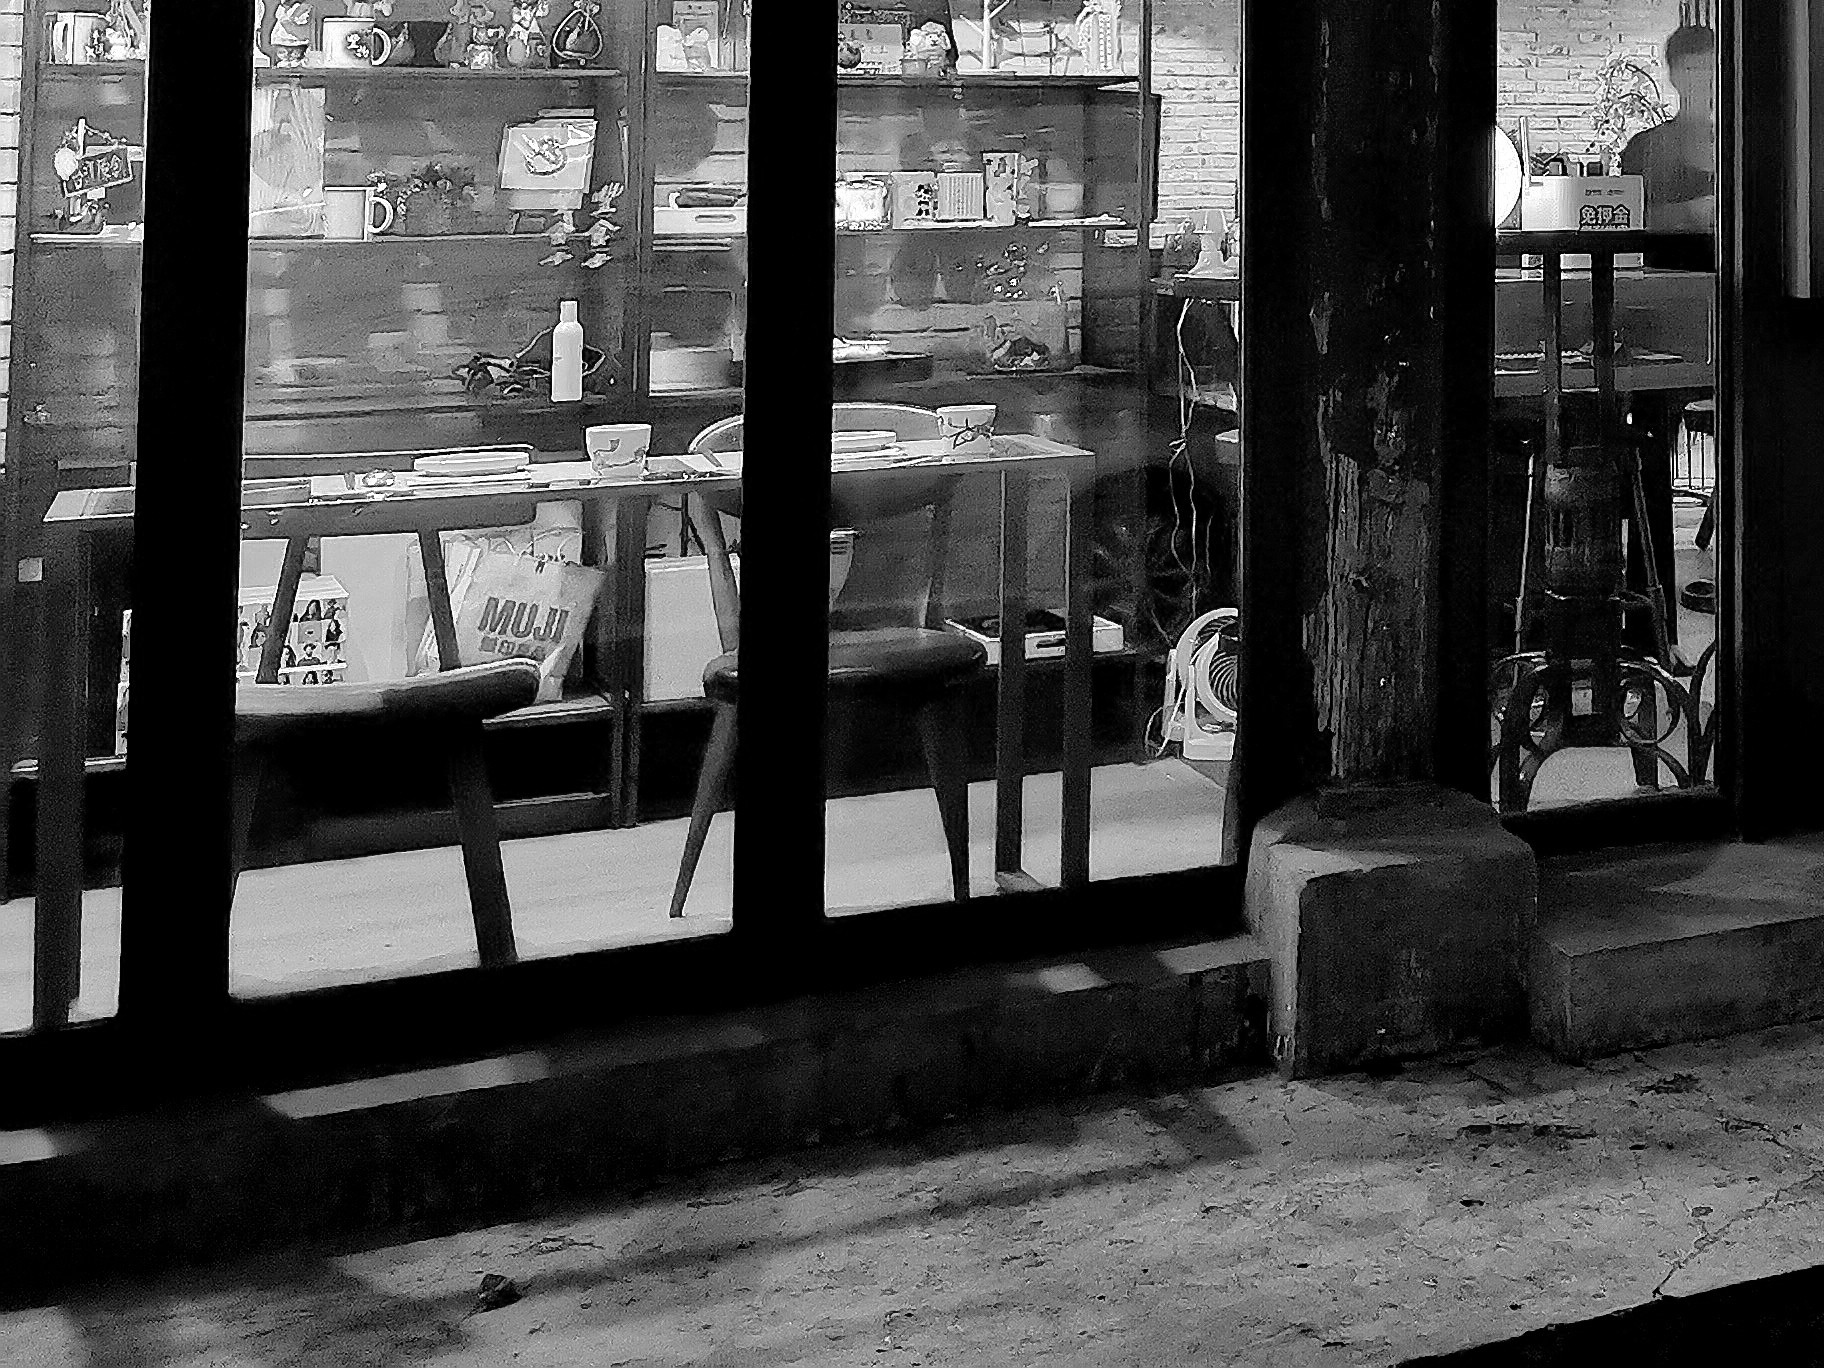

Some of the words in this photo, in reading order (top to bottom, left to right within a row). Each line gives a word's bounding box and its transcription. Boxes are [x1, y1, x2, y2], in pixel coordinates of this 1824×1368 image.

[1580, 205, 1629, 224] 免押金
[478, 597, 570, 644] MUJI
